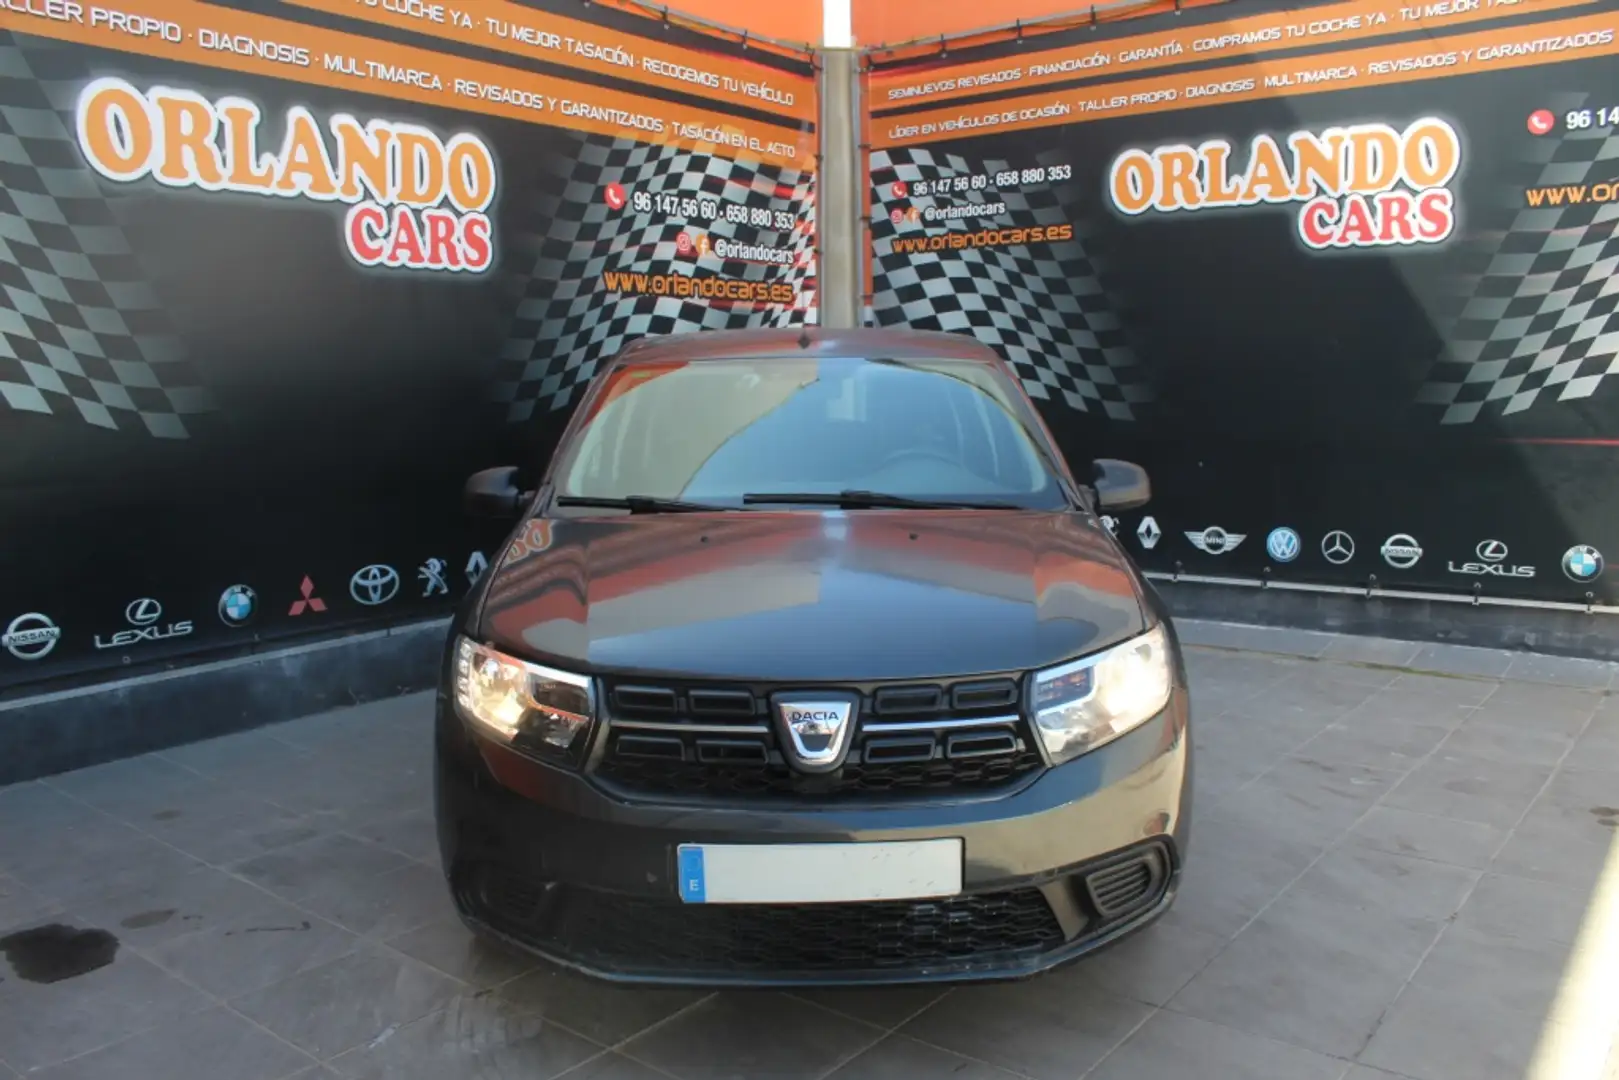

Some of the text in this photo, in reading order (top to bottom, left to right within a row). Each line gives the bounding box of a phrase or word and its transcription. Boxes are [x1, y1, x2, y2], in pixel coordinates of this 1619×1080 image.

[383, 0, 794, 106] COCHE YA TU MEJOR TASACIÓN RECOGEMOS TU VEHÍCULO
[888, 0, 1480, 100] SEMINUEVOS REVISADOS FINANCIACIÓN GARANTÍA COMPRAMOS TU COCHE YA TU MEJOR
[90, 7, 182, 42] PROPIO
[199, 28, 310, 66] DIAGNOSIS
[324, 53, 443, 91] MULTIMARCA
[454, 78, 543, 110] REVISADOS
[547, 97, 558, 112] Y
[560, 100, 664, 133] GARANTIZADOS
[672, 121, 731, 146] TASACIÓN
[731, 133, 748, 149] EN
[750, 137, 765, 152] EL
[766, 141, 796, 158] ACTO
[888, 28, 1615, 139] LÍDER EN VEHÍCULOS DE OCASIÓN TALLER PROPIO DIAGNOSIS MULTIMARCA REVISADOS Y GARANTIZADOS
[1566, 109, 1592, 130] 96
[77, 76, 496, 213] ORLANDO
[913, 164, 1072, 196] 96 147 56 60 658 880 353
[1109, 116, 1460, 216] ORLANDO
[633, 191, 795, 229] 96 147 56 60 658 880 353
[924, 199, 1006, 221] @orlandocars
[1299, 187, 1454, 250] CARS
[345, 201, 493, 273] CARS
[714, 238, 794, 265] @orlandocars
[892, 222, 1073, 254] www.orlandocars.es
[604, 271, 794, 302] www.orlandocars.es
[1448, 560, 1536, 578] LEXUS
[8, 628, 57, 643] NISSAN
[94, 620, 193, 649] LEXUS
[790, 711, 840, 721] DACIA
[690, 879, 699, 891] E
